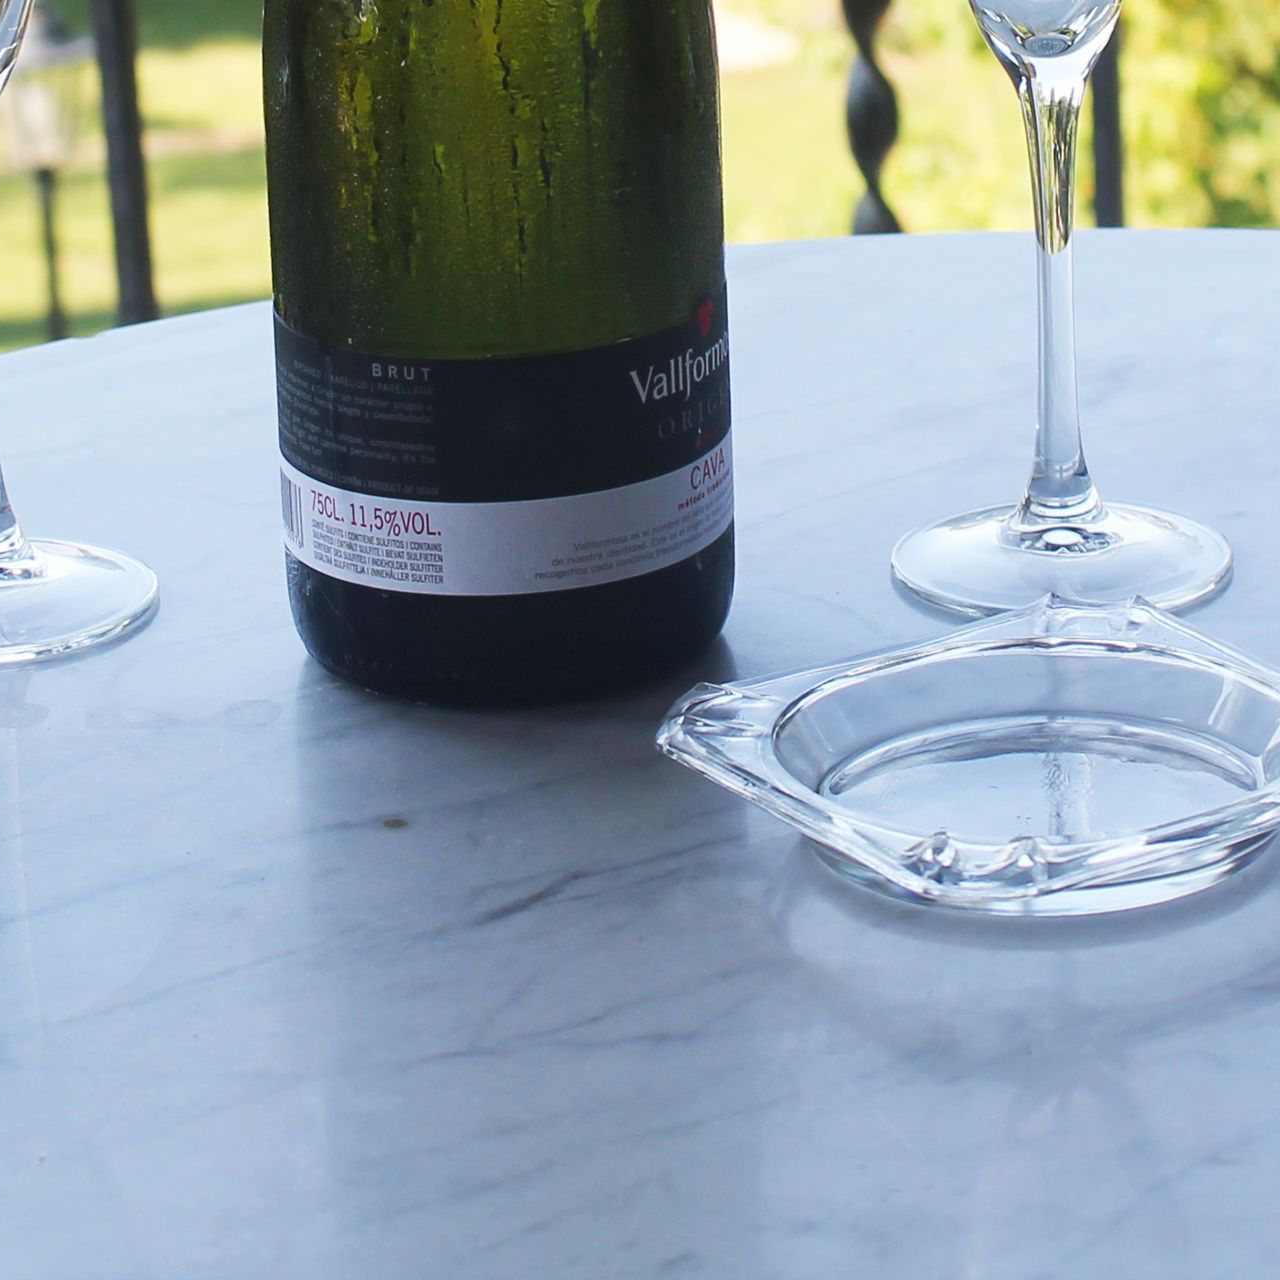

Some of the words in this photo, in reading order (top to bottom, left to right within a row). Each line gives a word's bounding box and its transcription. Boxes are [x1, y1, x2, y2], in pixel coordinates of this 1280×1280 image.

[371, 362, 431, 382] BRUT
[690, 447, 725, 490] CAVA
[310, 489, 345, 522] 75CL.
[349, 503, 442, 537] 11,5%VOL.
[409, 541, 443, 552] CONTAINS
[551, 557, 564, 568] de
